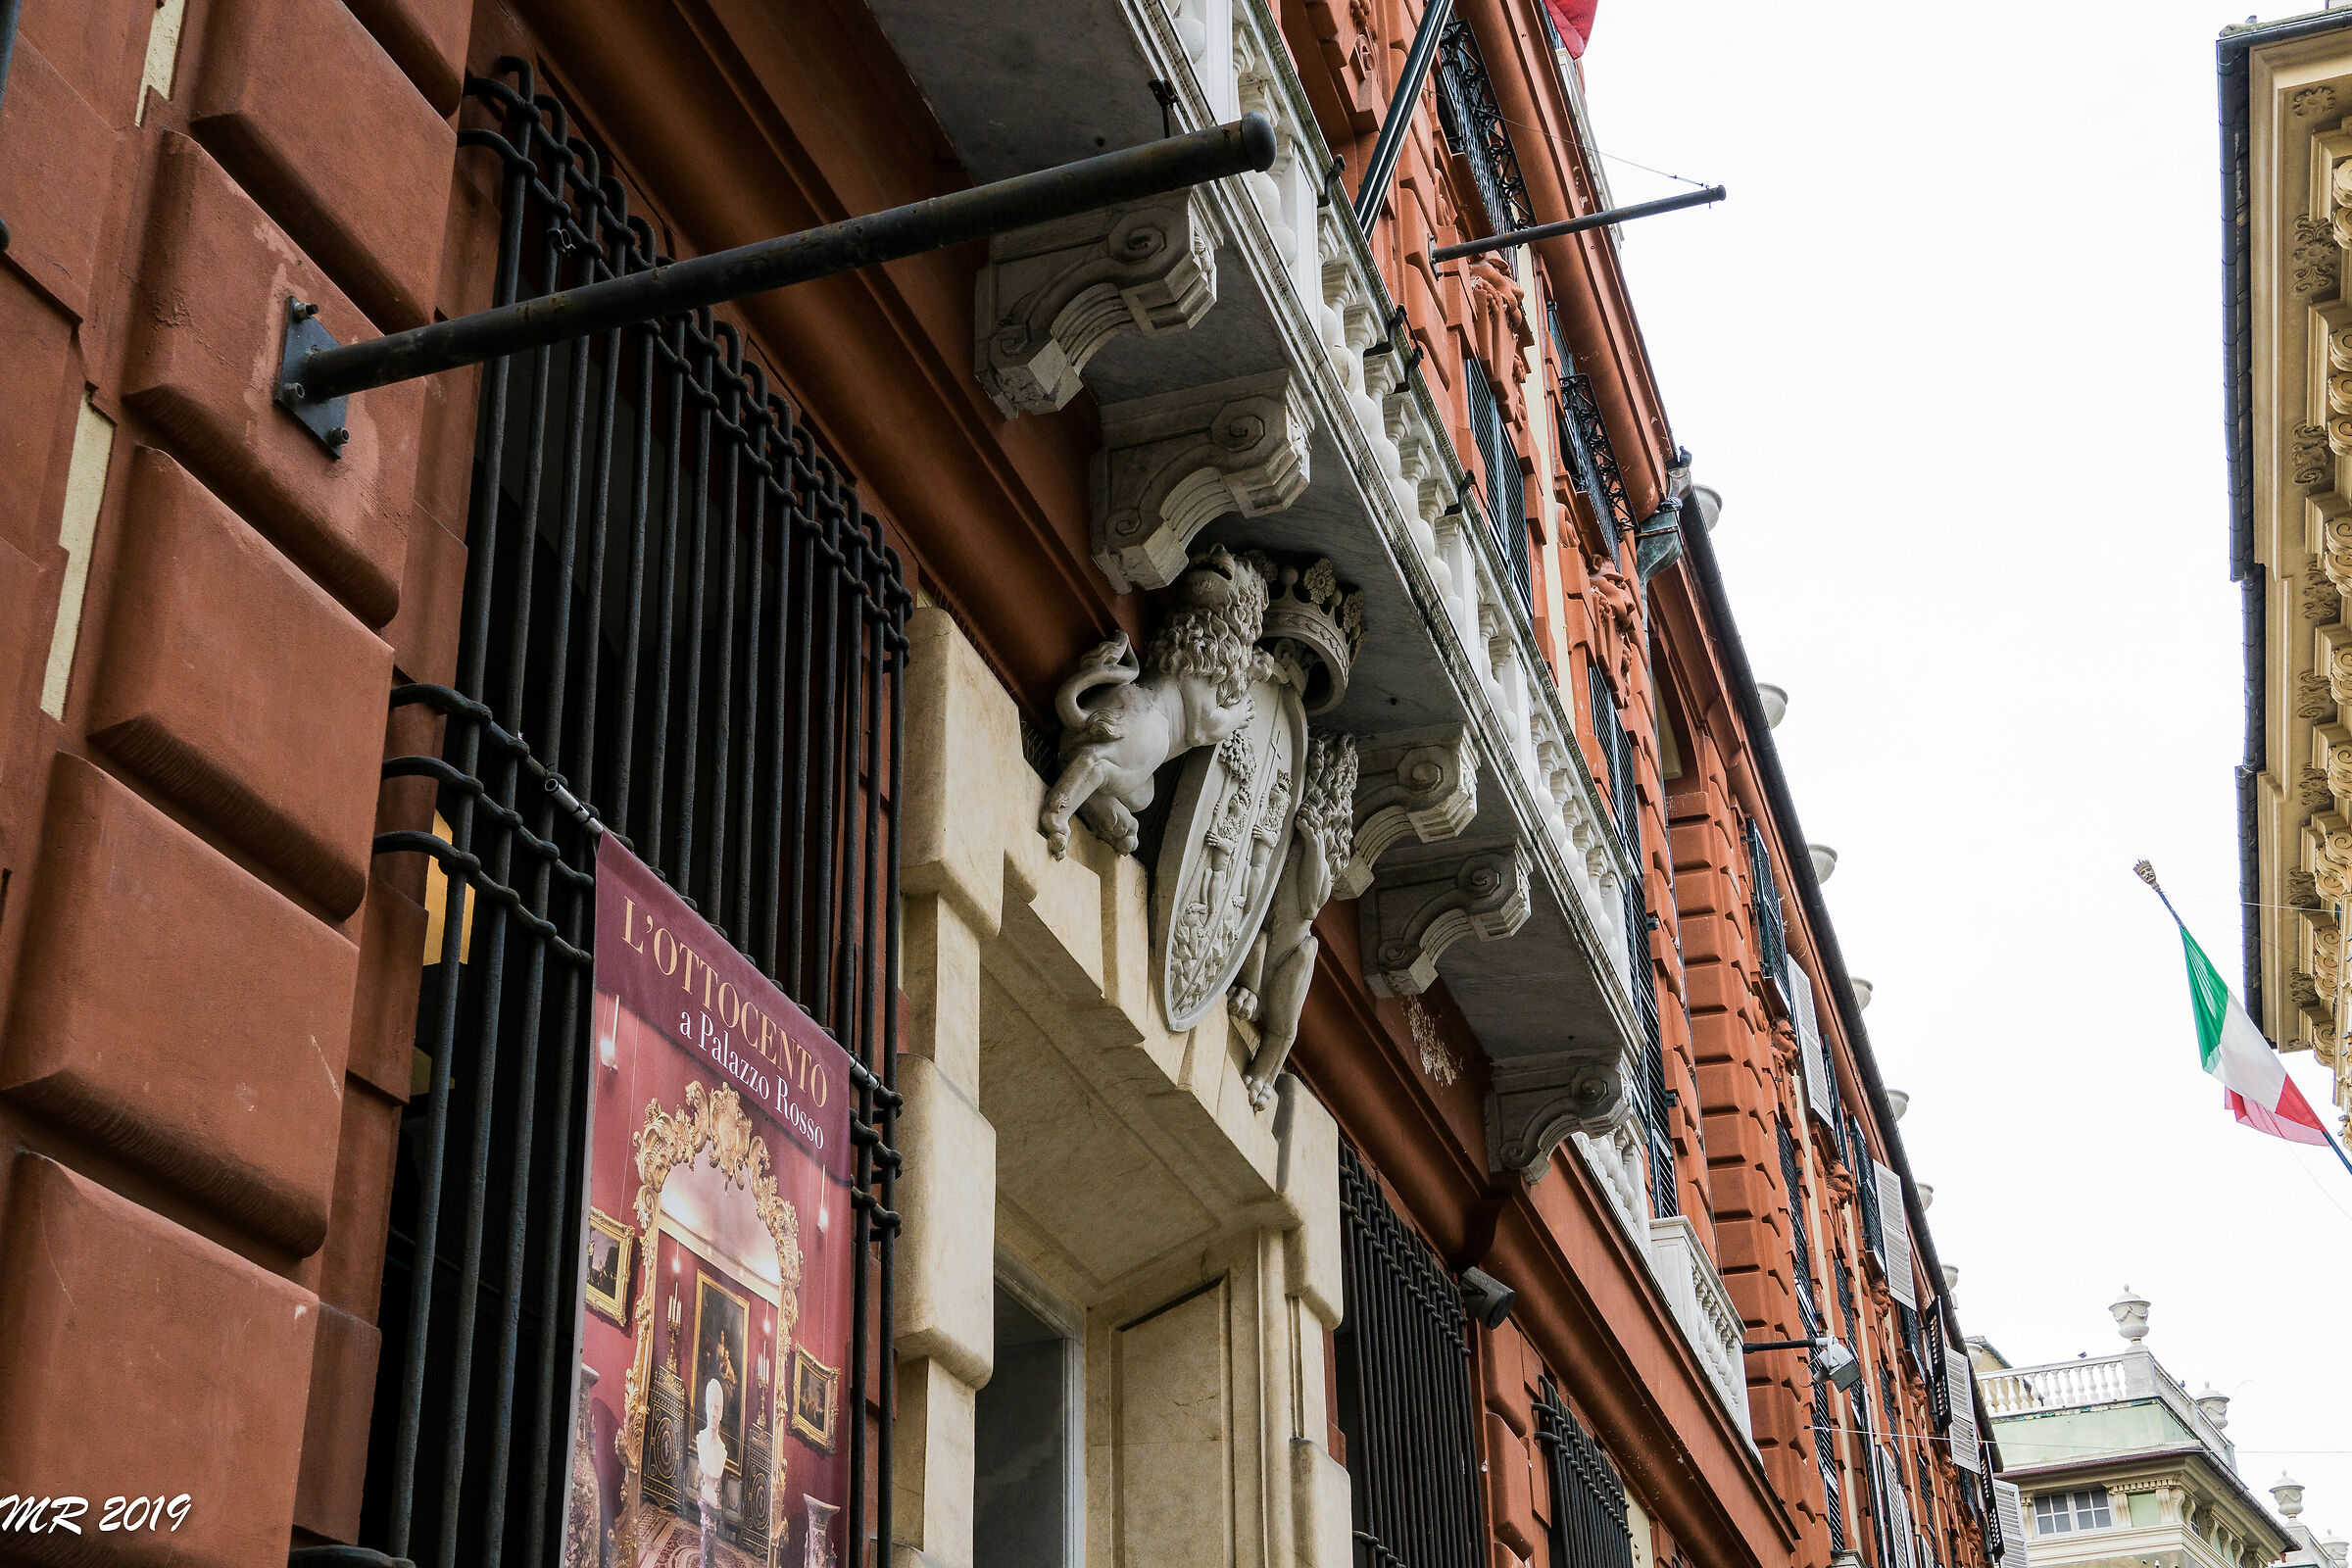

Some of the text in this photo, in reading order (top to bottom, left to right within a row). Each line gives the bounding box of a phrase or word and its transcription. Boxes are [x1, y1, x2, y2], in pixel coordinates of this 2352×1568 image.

[622, 896, 828, 1108] L'OTTOCENTO
[679, 1010, 824, 1150] a Palazzo Rosso
